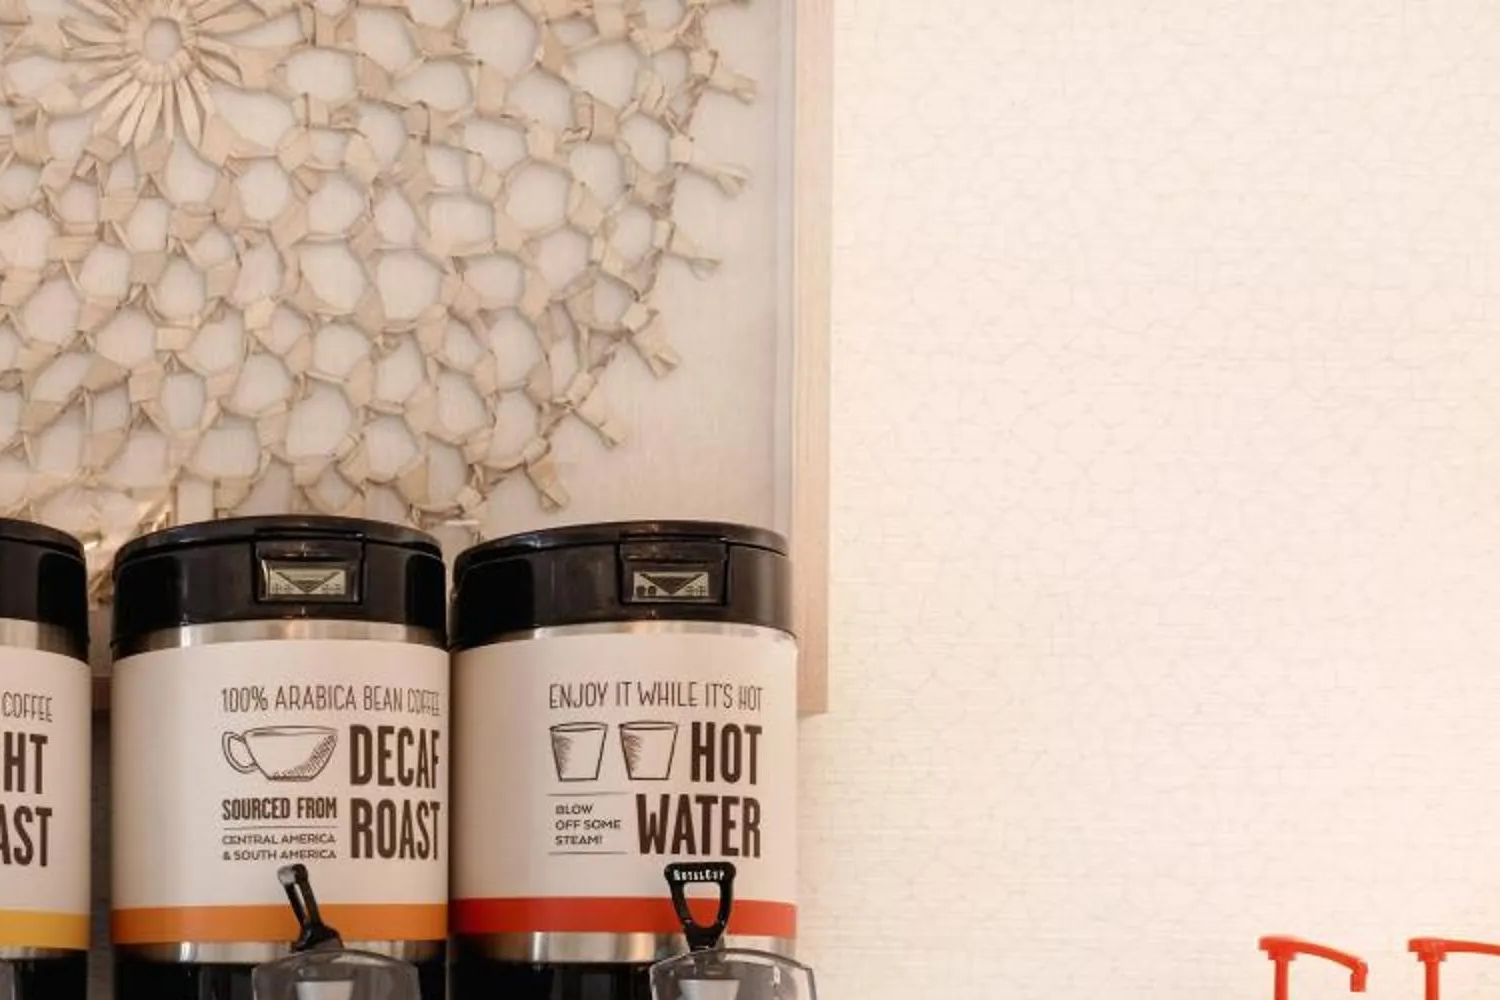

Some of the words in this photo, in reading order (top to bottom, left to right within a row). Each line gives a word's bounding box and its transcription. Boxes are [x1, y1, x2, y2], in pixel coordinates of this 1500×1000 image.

[3, 691, 53, 723] COFFEE
[221, 686, 269, 713] 100%
[274, 685, 357, 711] ARABICA
[363, 685, 403, 713] BEAN
[549, 681, 609, 709] ENJOY
[615, 681, 633, 707] IT
[637, 681, 698, 707] WHILE
[705, 683, 733, 709] IT'S
[738, 685, 764, 711] HOT
[349, 723, 441, 789] DECAF
[690, 721, 763, 785] HOT
[221, 797, 291, 820] SOURCED
[296, 796, 338, 819] FROM
[555, 804, 594, 815] BLOW
[222, 834, 279, 845] CENTRAL
[281, 833, 336, 845] AMERICA
[349, 797, 441, 861] ROAST
[555, 819, 581, 831] OFF
[583, 819, 622, 830] SOME
[635, 793, 762, 858] WATER
[555, 835, 603, 846] STEAM!
[233, 850, 277, 861] SOUTH
[280, 849, 337, 860] AMERICA
